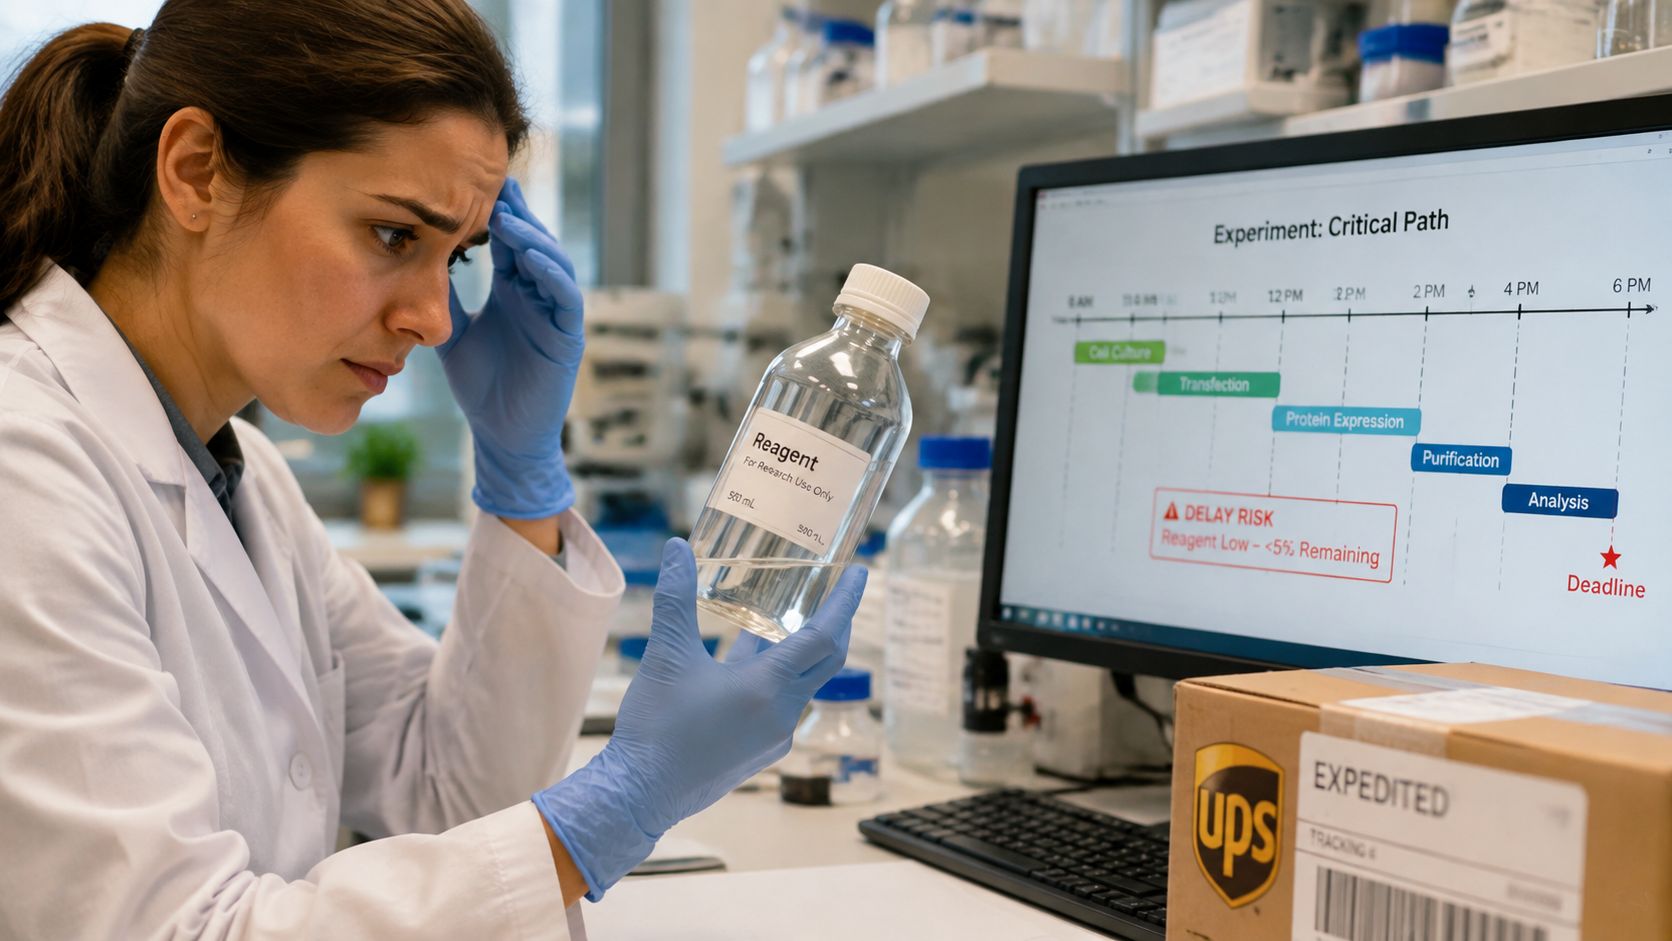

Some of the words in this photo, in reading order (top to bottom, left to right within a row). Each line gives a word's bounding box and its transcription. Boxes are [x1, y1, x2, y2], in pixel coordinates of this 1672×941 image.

[1213, 219, 1323, 247] Experiment:
[1328, 211, 1397, 237] Critical
[1403, 209, 1449, 232] Path
[1344, 287, 1366, 301] PM
[1413, 286, 1421, 299] 2
[1424, 284, 1445, 299] PM
[1504, 282, 1513, 296] 4
[1516, 281, 1540, 296] PM
[1613, 278, 1622, 293] 6
[1627, 278, 1652, 293] PM
[1268, 290, 1282, 303] 12
[1284, 289, 1303, 302] PM
[1111, 345, 1151, 360] Culture
[1180, 376, 1250, 392] Transfection
[1286, 411, 1331, 427] Protein
[1334, 412, 1404, 430] Expression
[753, 433, 818, 471] Reagent
[1422, 450, 1500, 469] Purification
[744, 456, 756, 466] For
[813, 487, 833, 502] Only
[1528, 492, 1589, 512] Analysis
[1184, 504, 1234, 524] DELAY
[1237, 509, 1274, 528] RISK
[1162, 529, 1217, 551] Reagent
[1221, 534, 1249, 552] Low
[1265, 539, 1295, 557] <5%
[1299, 541, 1380, 570] Remaining
[1567, 574, 1646, 599] Deadline
[1314, 761, 1449, 818] EXPEDITED
[1199, 788, 1278, 878] ups
[1310, 828, 1366, 859] TRACKING
